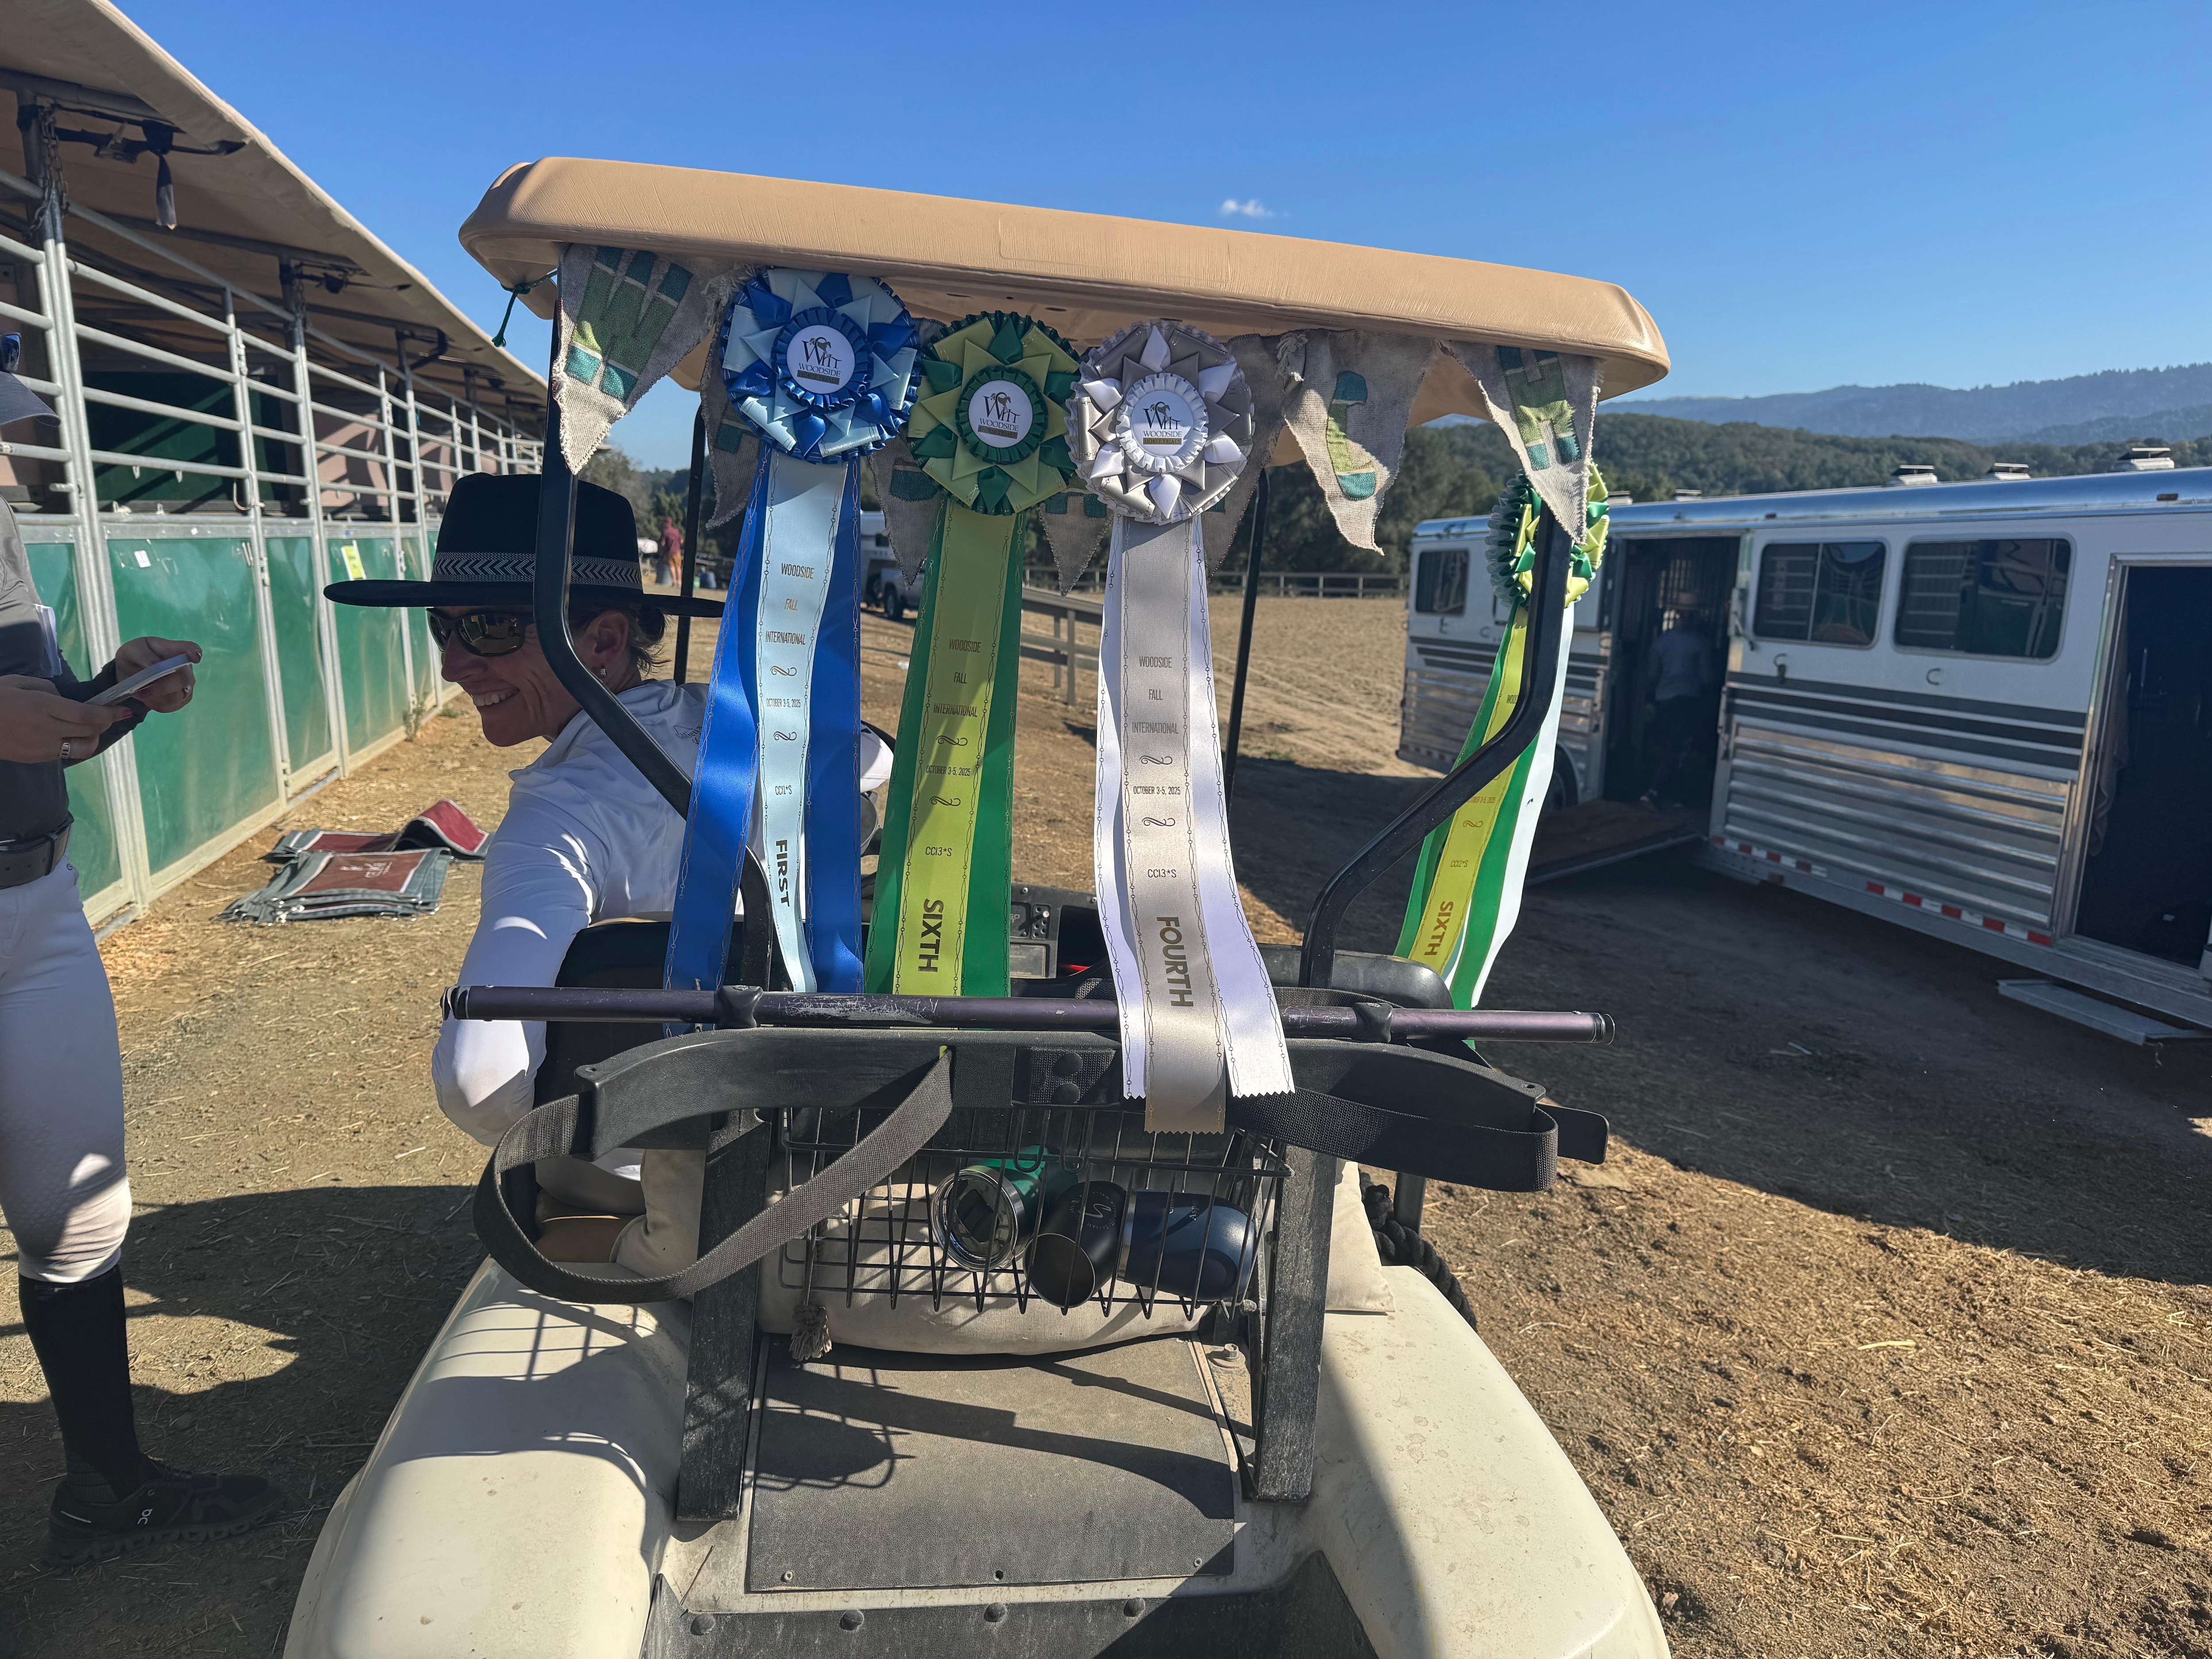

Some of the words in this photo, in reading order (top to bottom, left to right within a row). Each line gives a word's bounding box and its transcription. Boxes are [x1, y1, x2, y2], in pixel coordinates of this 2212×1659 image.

[799, 363, 841, 377] WOODSIDE
[980, 418, 1019, 431] WOODSIDE
[781, 563, 814, 579] WOODSIDE
[784, 598, 798, 611] FALL
[765, 630, 806, 645] INTERNATIONAL
[949, 638, 981, 653] WOODSIDE
[1139, 656, 1172, 668] WOODSIDE
[954, 672, 968, 684] FALL
[1148, 689, 1163, 700] FALL
[766, 698, 782, 707] OCTOBER
[791, 699, 801, 707] 2025
[933, 703, 977, 717] INTERNATIONAL
[1132, 722, 1179, 734] INTERNATIONAL
[926, 765, 947, 775] OCTOBER
[948, 767, 957, 776] 3-5,
[959, 767, 971, 776] 2025
[1133, 786, 1155, 795] OCTOBER
[1156, 786, 1167, 795] 3-5,
[1168, 787, 1180, 795] 2025
[776, 840, 790, 907] FIRST
[1424, 901, 1454, 956] SIXTH
[918, 899, 944, 972] SIXTH
[1156, 916, 1194, 1008] FOURTH
